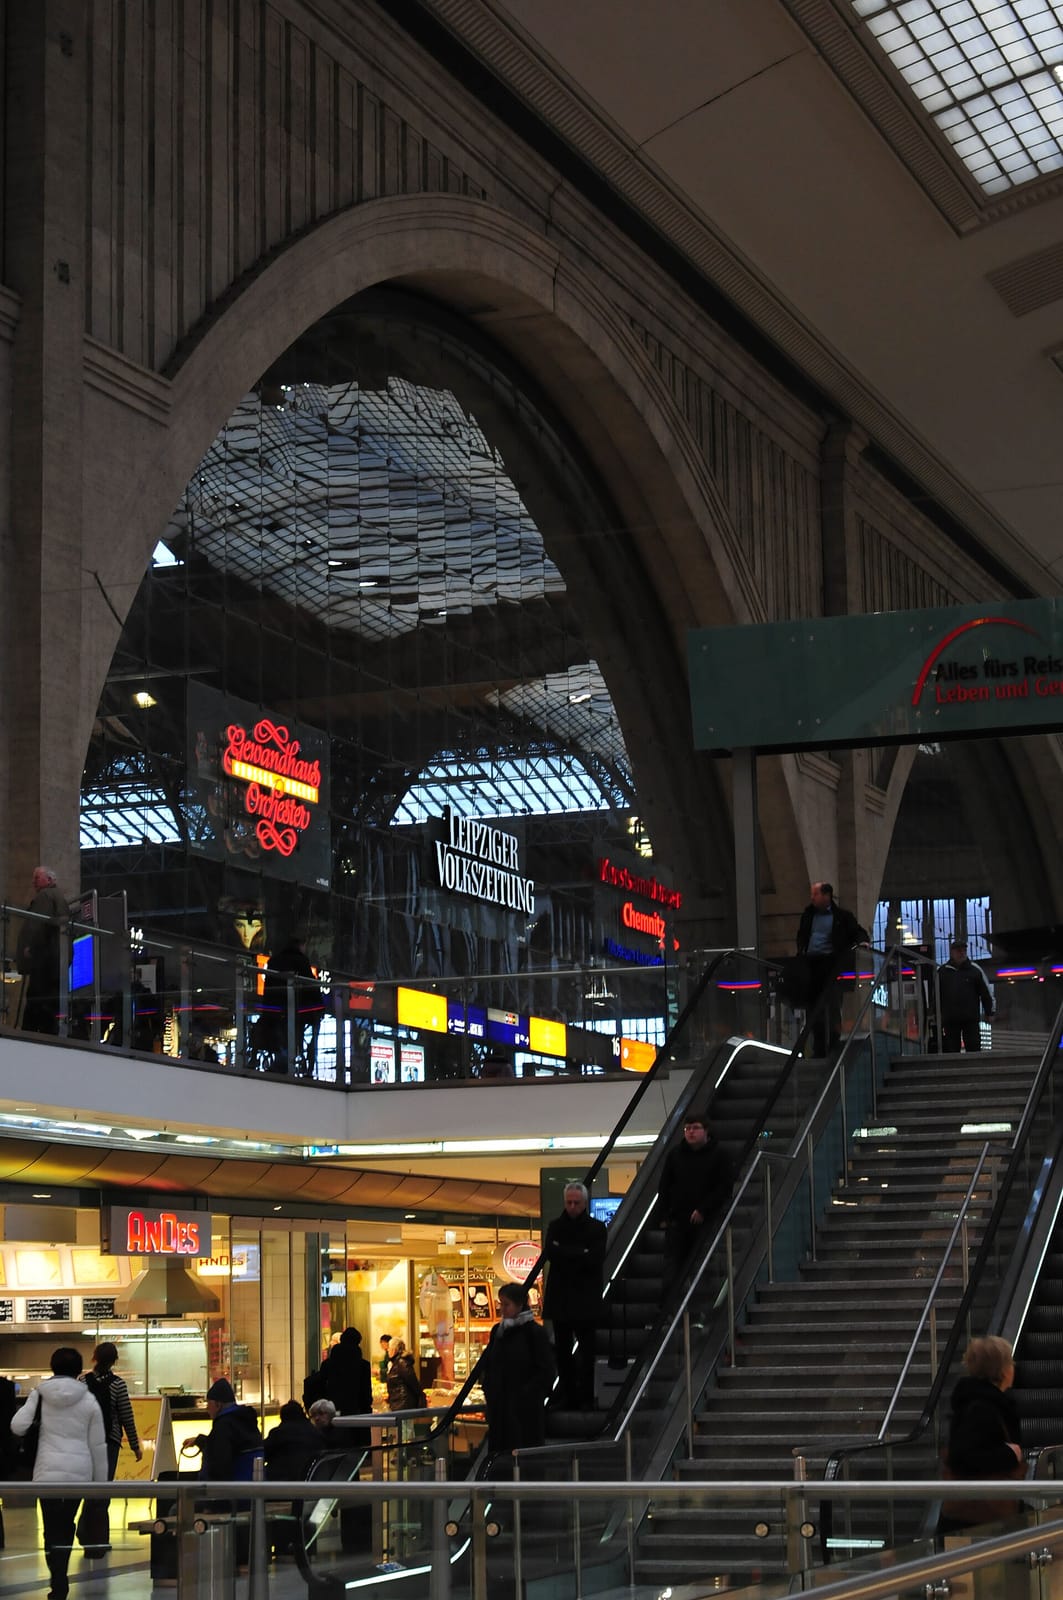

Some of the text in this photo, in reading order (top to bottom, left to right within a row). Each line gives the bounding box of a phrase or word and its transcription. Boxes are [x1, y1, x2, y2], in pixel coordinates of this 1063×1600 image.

[935, 662, 978, 682] Alles
[984, 658, 1019, 678] fürs
[935, 676, 1063, 704] Leben und Ge
[223, 720, 321, 788] Gewandhaus
[246, 780, 311, 848] Orchester
[448, 807, 520, 871] LEIPZIGER
[435, 840, 535, 914] VOLKSZEITUNG
[623, 902, 666, 938] Chemnitz
[611, 1037, 620, 1056] 16
